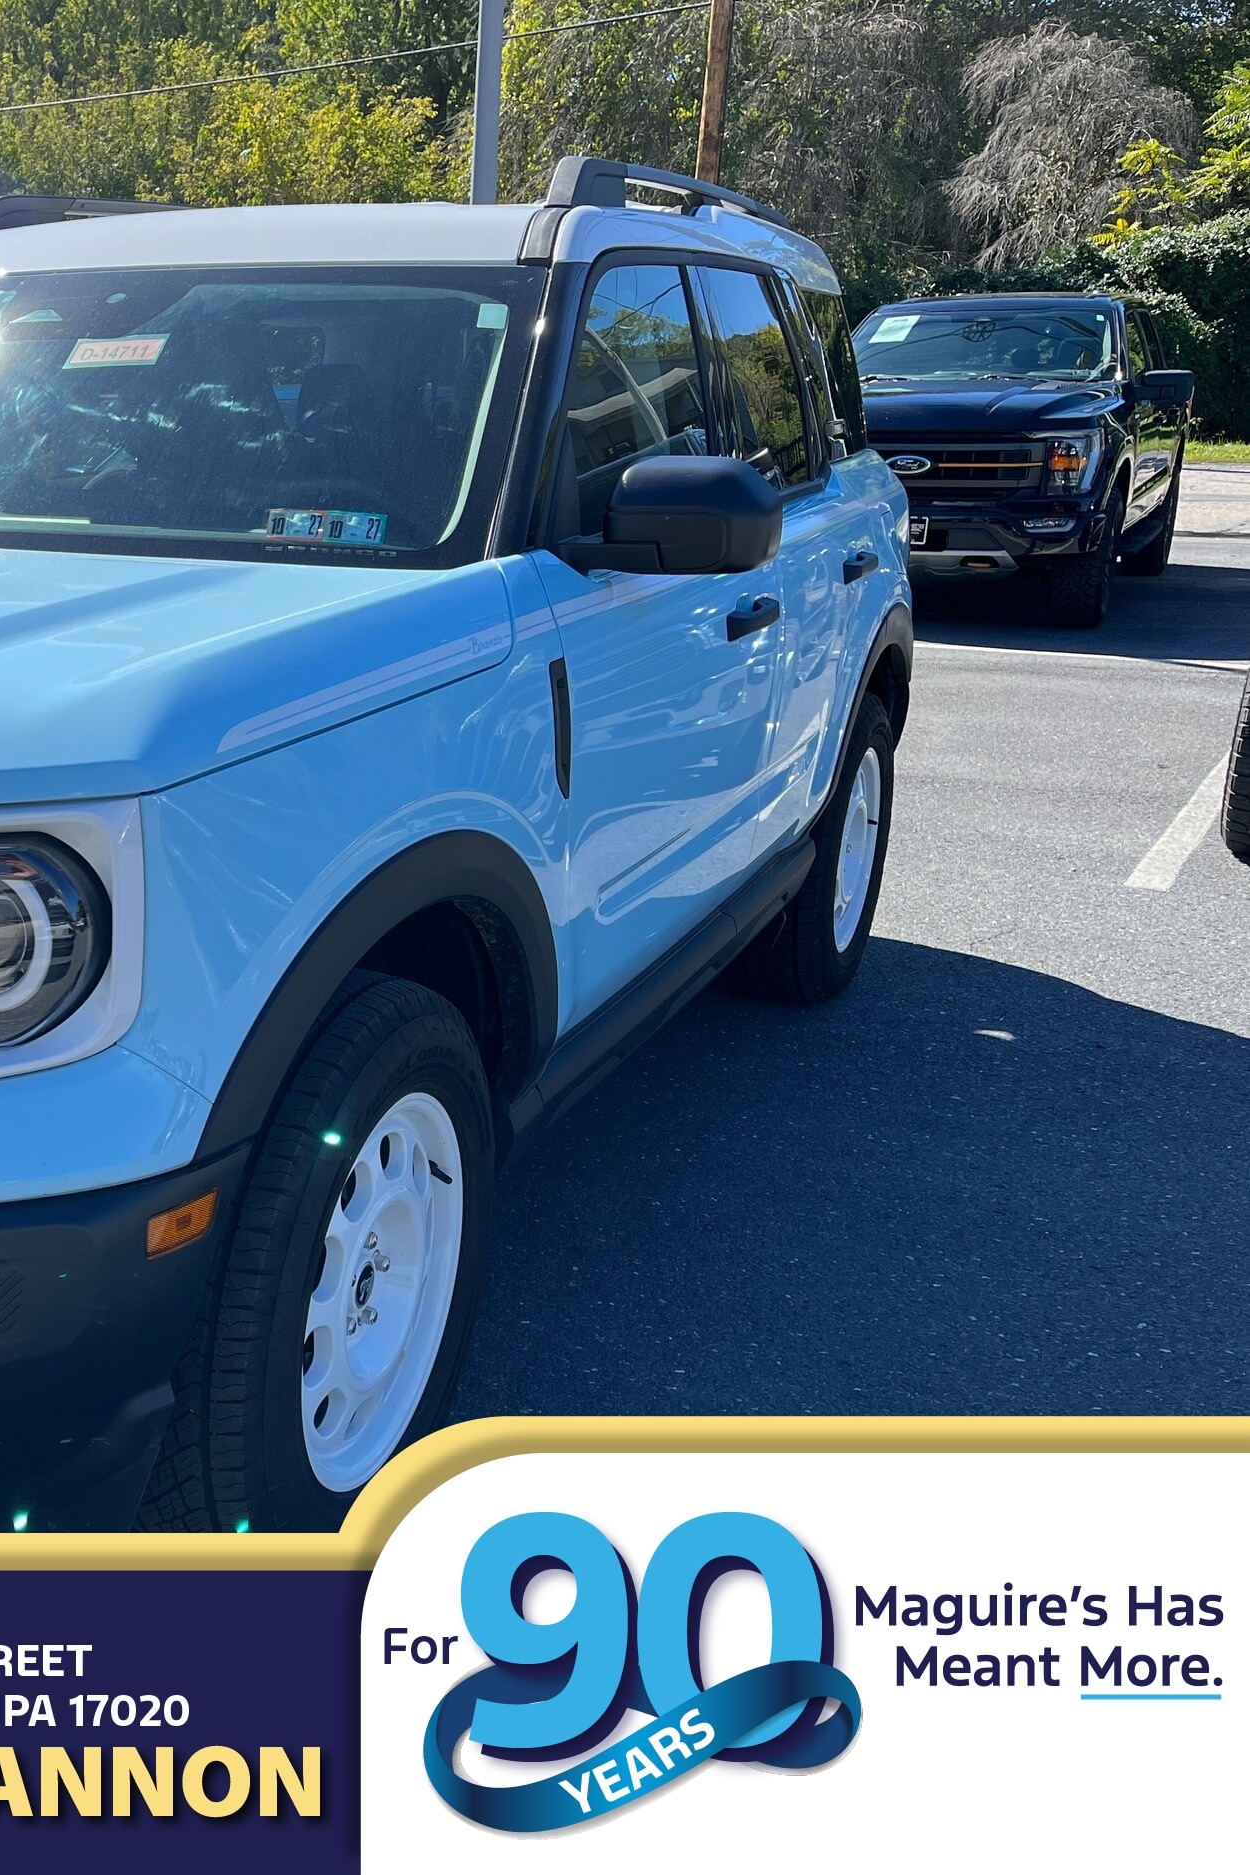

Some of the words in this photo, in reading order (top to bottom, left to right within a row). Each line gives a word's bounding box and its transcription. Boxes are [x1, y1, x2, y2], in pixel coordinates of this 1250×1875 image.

[80, 344, 150, 361] D-14711
[271, 517, 286, 535] 10
[308, 514, 323, 538] 27
[329, 520, 344, 538] 10
[365, 518, 381, 541] 27
